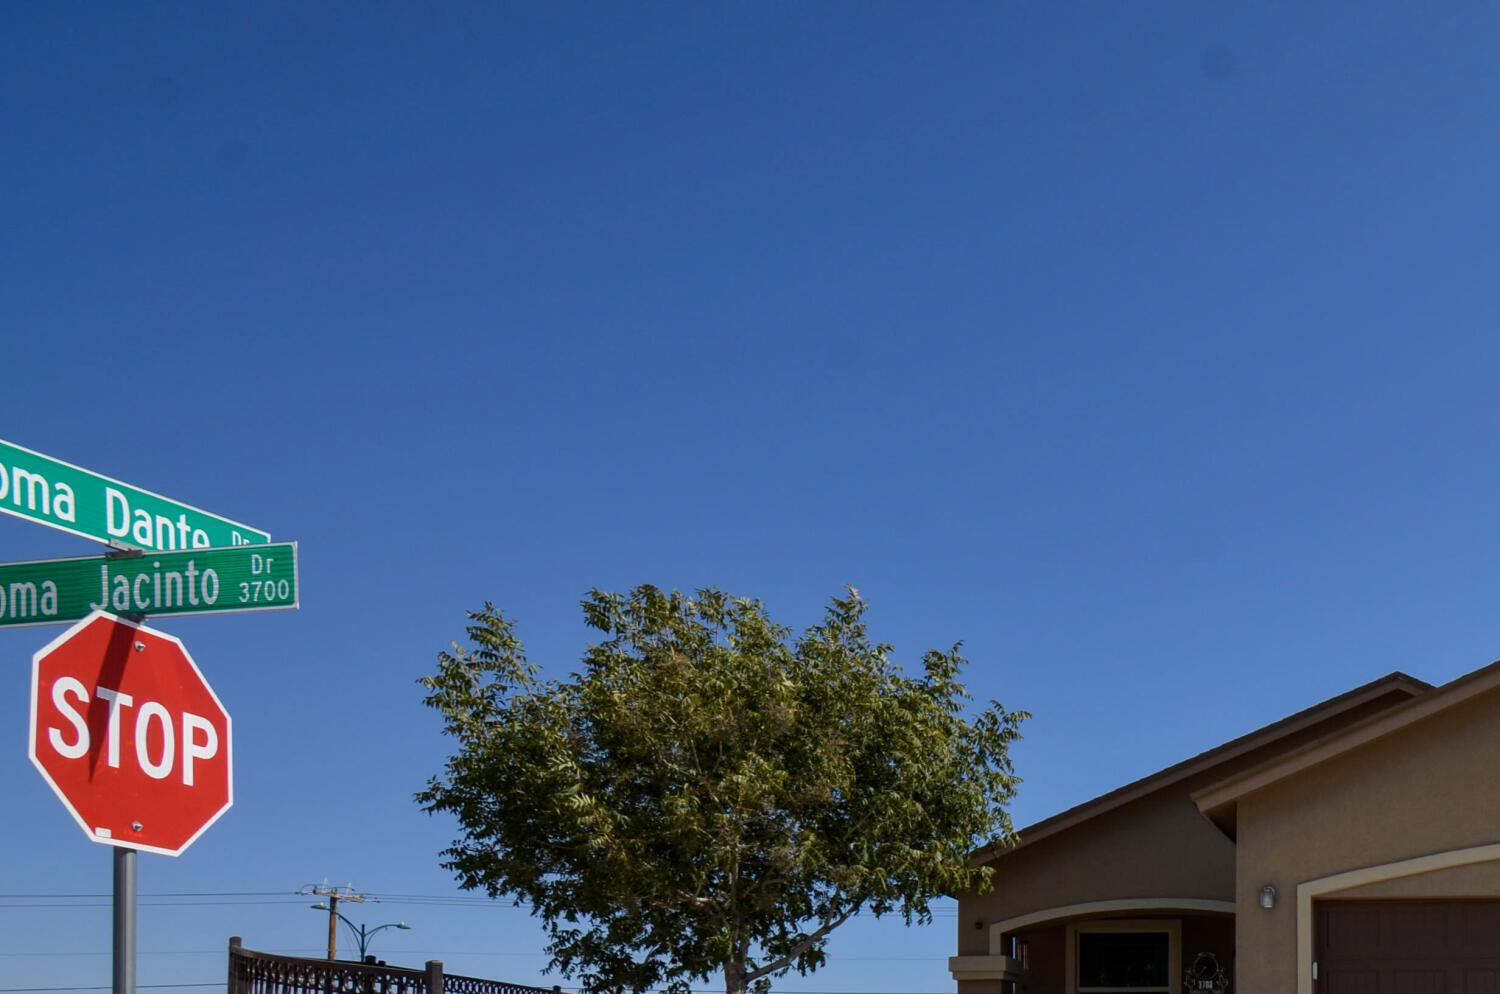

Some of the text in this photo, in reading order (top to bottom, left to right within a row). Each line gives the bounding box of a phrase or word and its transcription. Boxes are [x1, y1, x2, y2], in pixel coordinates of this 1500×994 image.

[106, 486, 210, 551] Dante
[90, 560, 219, 611] Jacinto
[251, 554, 274, 575] Dr
[239, 580, 290, 602] 3700
[48, 676, 218, 787] STOP
